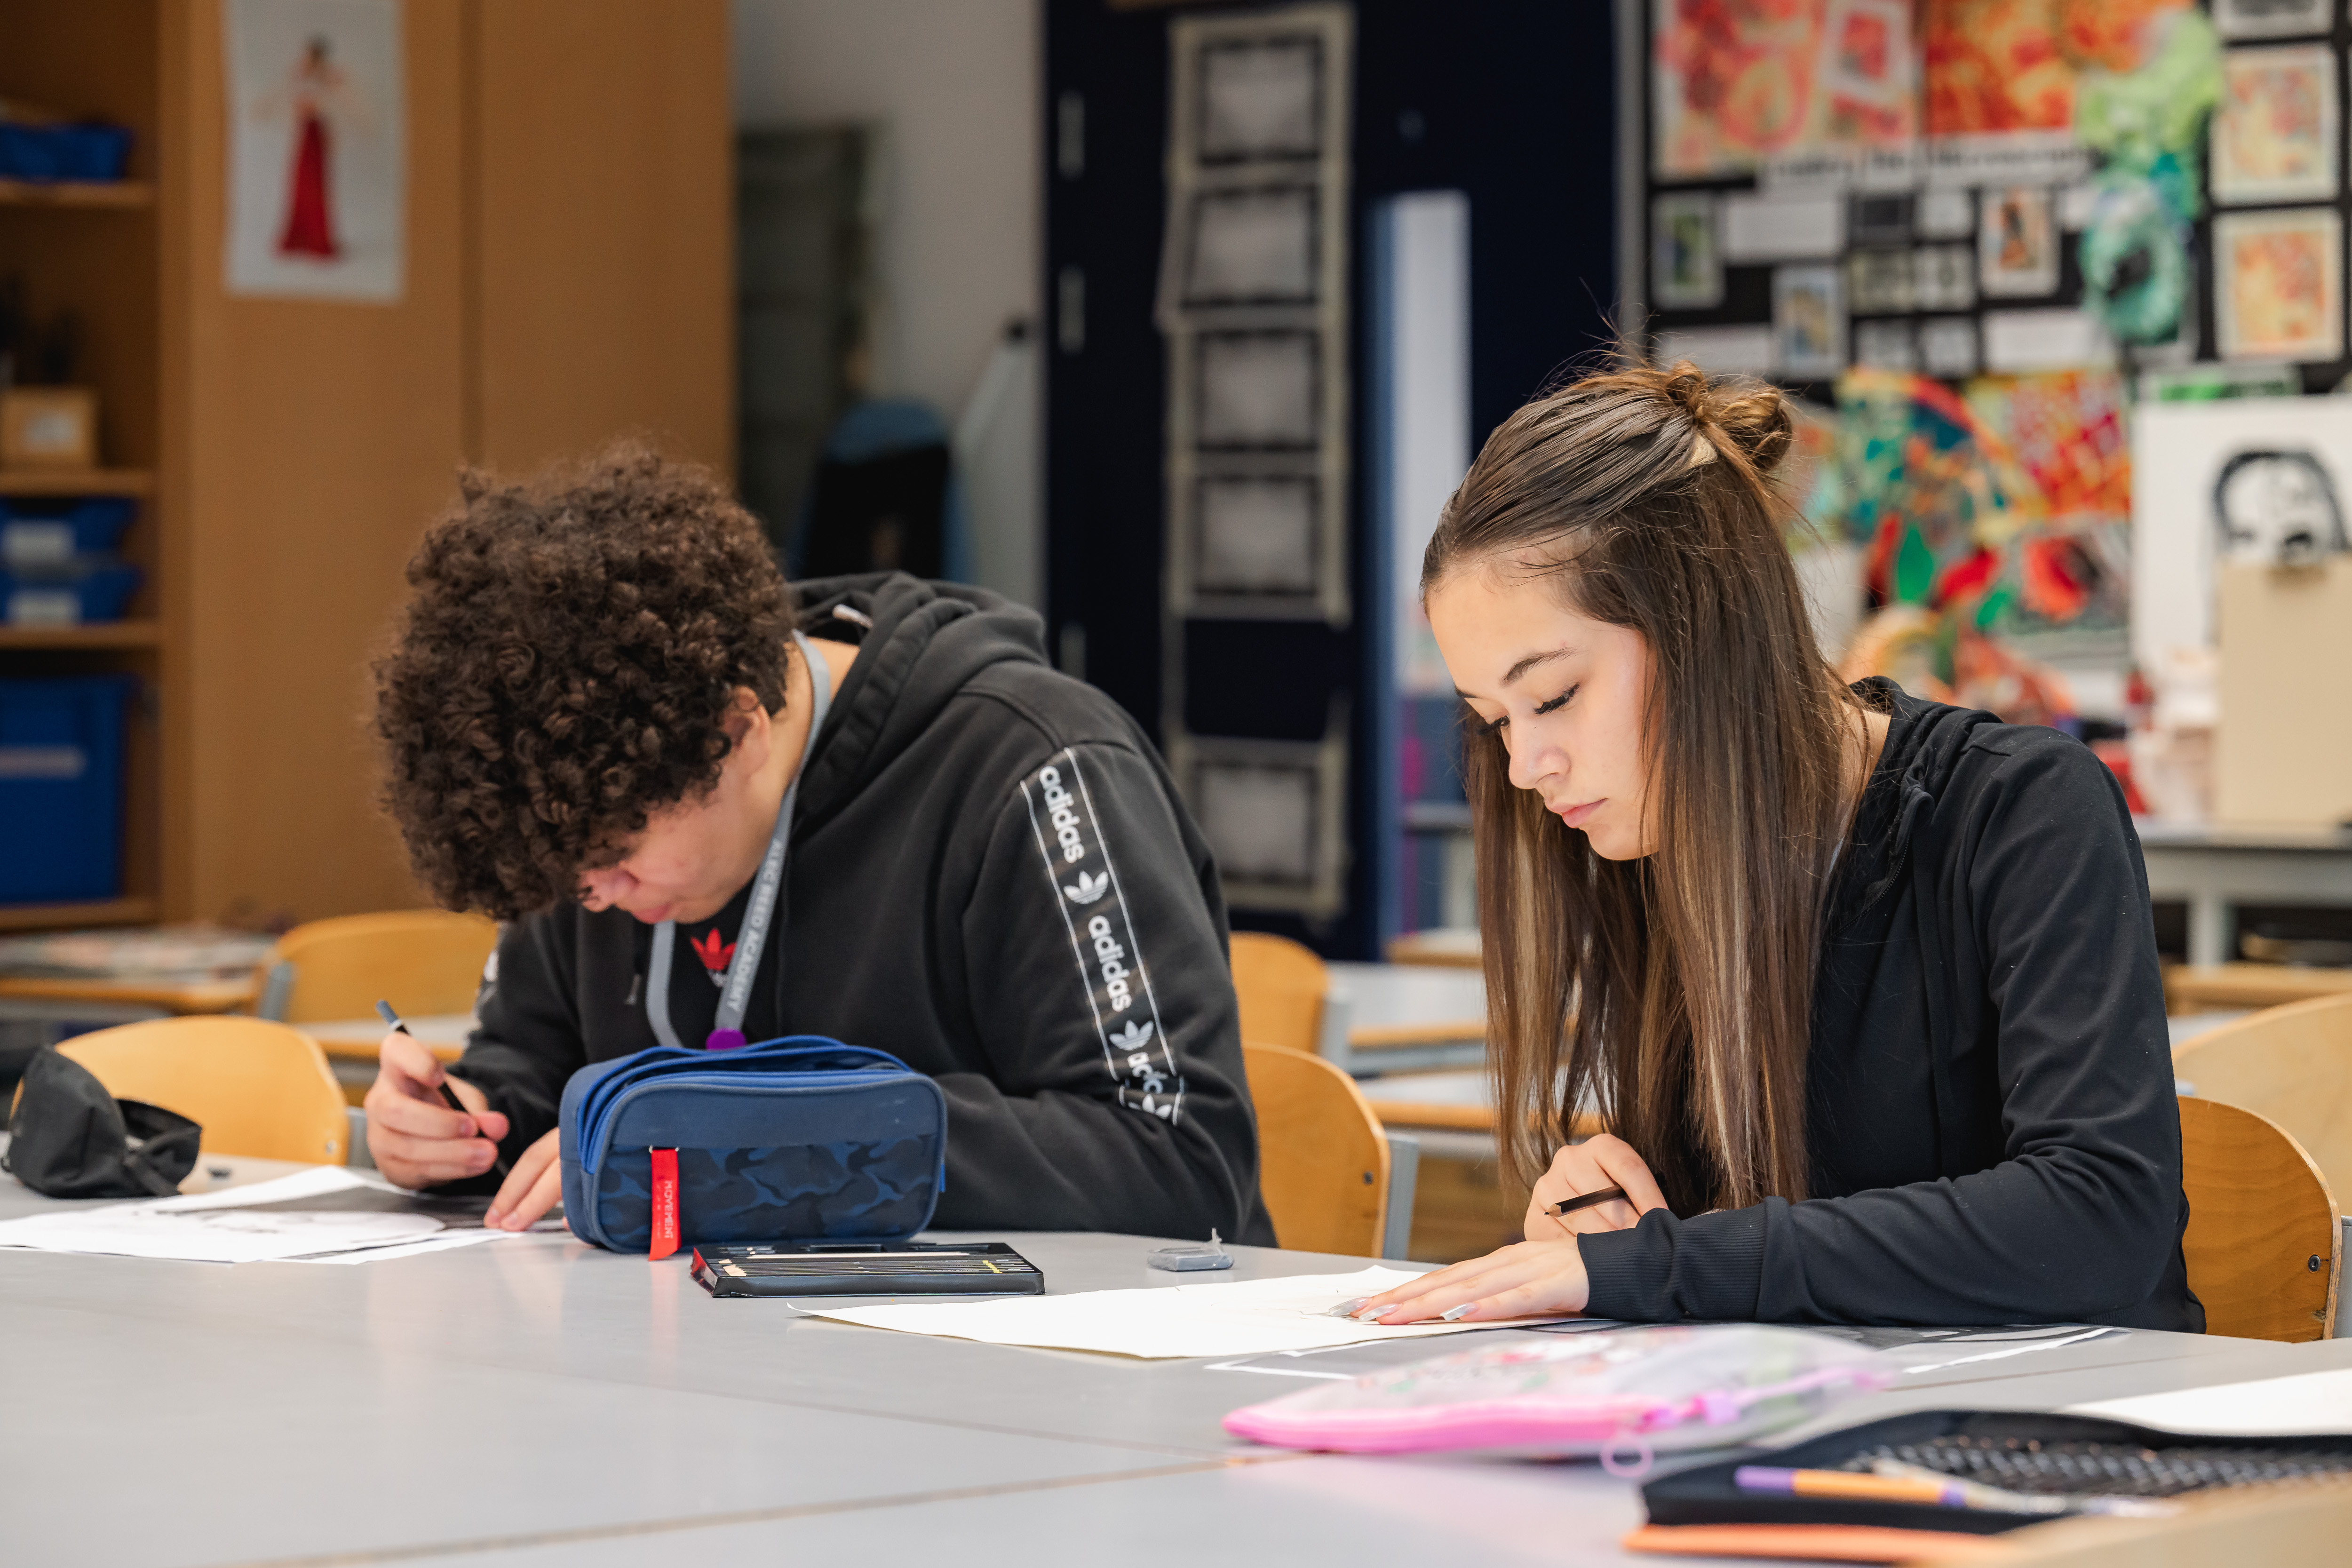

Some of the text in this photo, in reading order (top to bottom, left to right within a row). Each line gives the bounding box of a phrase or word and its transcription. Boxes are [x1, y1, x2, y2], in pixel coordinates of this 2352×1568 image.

[1039, 765, 1085, 864] adidas
[726, 839, 783, 1012] ALEC REED ACADEMY
[1088, 915, 1132, 1012] adidas
[664, 1180, 674, 1239] MOVEMENT
